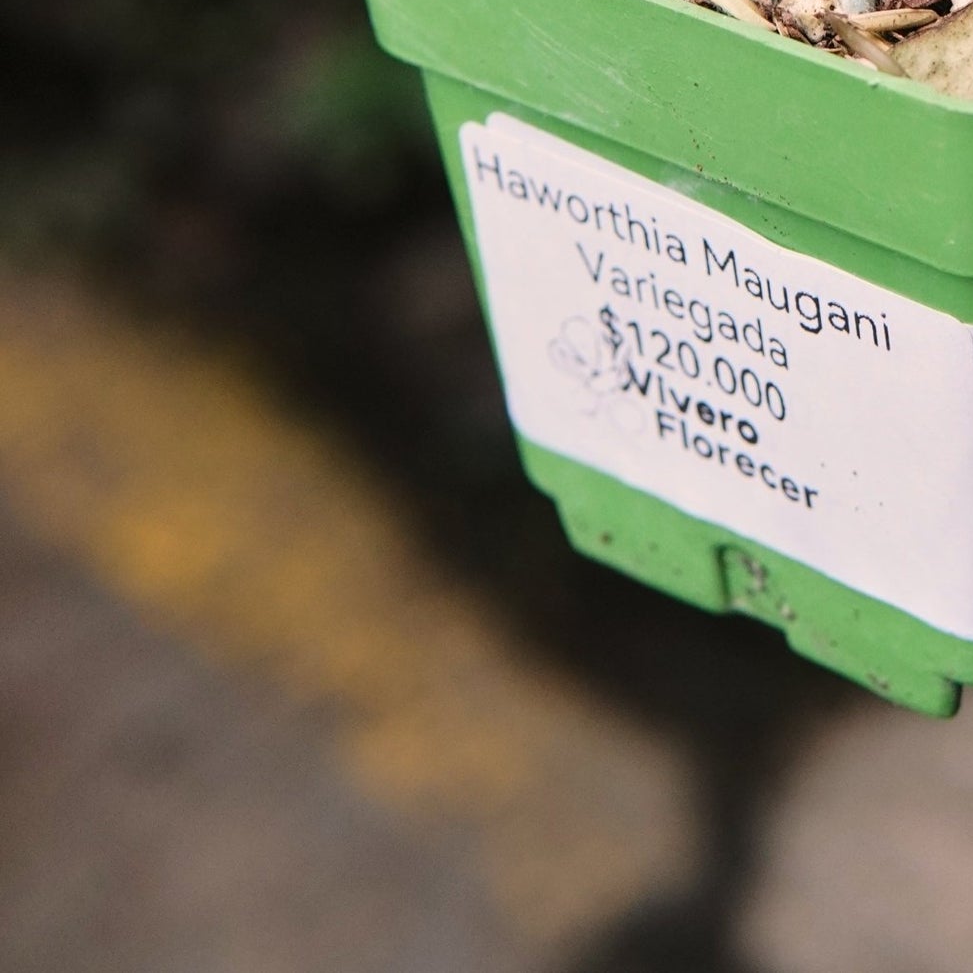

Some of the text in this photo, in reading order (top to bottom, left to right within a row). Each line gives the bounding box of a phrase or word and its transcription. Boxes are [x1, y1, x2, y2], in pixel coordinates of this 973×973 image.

[474, 146, 892, 352] Haworthia Maugani
[576, 242, 788, 370] Variegada
[599, 303, 787, 422] $120.000
[656, 409, 819, 509] Florecer
